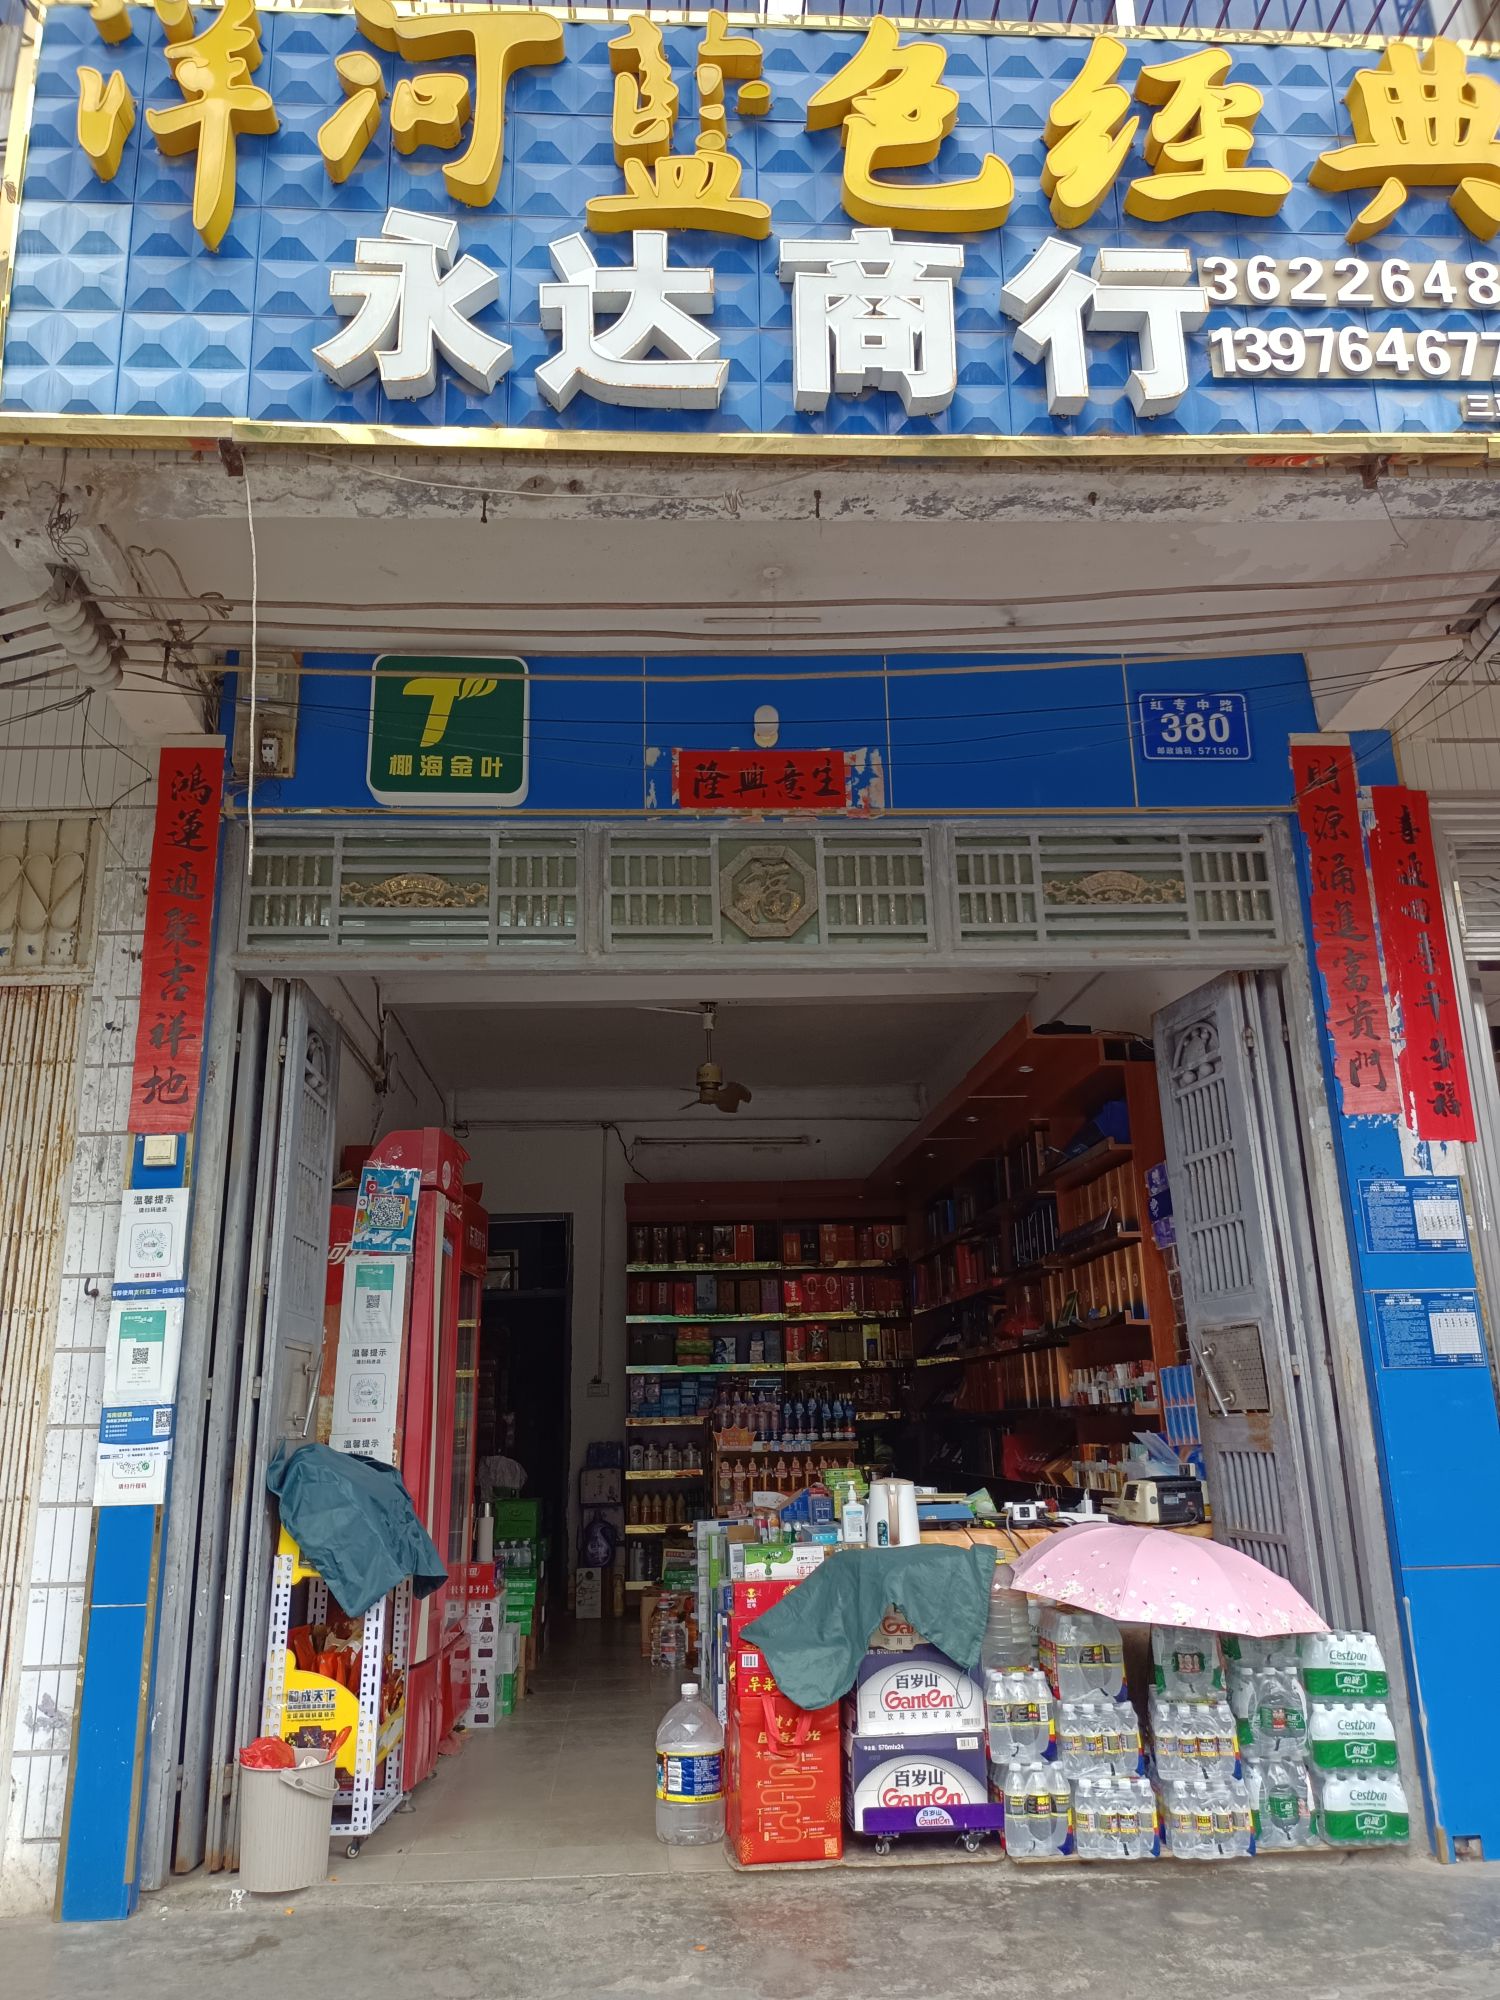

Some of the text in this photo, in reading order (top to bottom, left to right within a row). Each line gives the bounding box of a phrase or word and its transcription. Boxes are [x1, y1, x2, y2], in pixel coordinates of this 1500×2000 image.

[312, 207, 1209, 418] 永达商行
[1149, 698, 1233, 713] 红专中路
[1160, 713, 1230, 743] 380
[389, 755, 503, 778] 椰海金叶
[134, 1195, 175, 1205] 温馨提示
[352, 1348, 387, 1358] 温馨提示
[343, 1439, 380, 1449] 温馨提示
[896, 1673, 938, 1689] 百岁山
[288, 1689, 336, 1702] 和成天下
[887, 1710, 962, 1720] 饮用天然矿泉水
[895, 1769, 944, 1787] 百岁山
